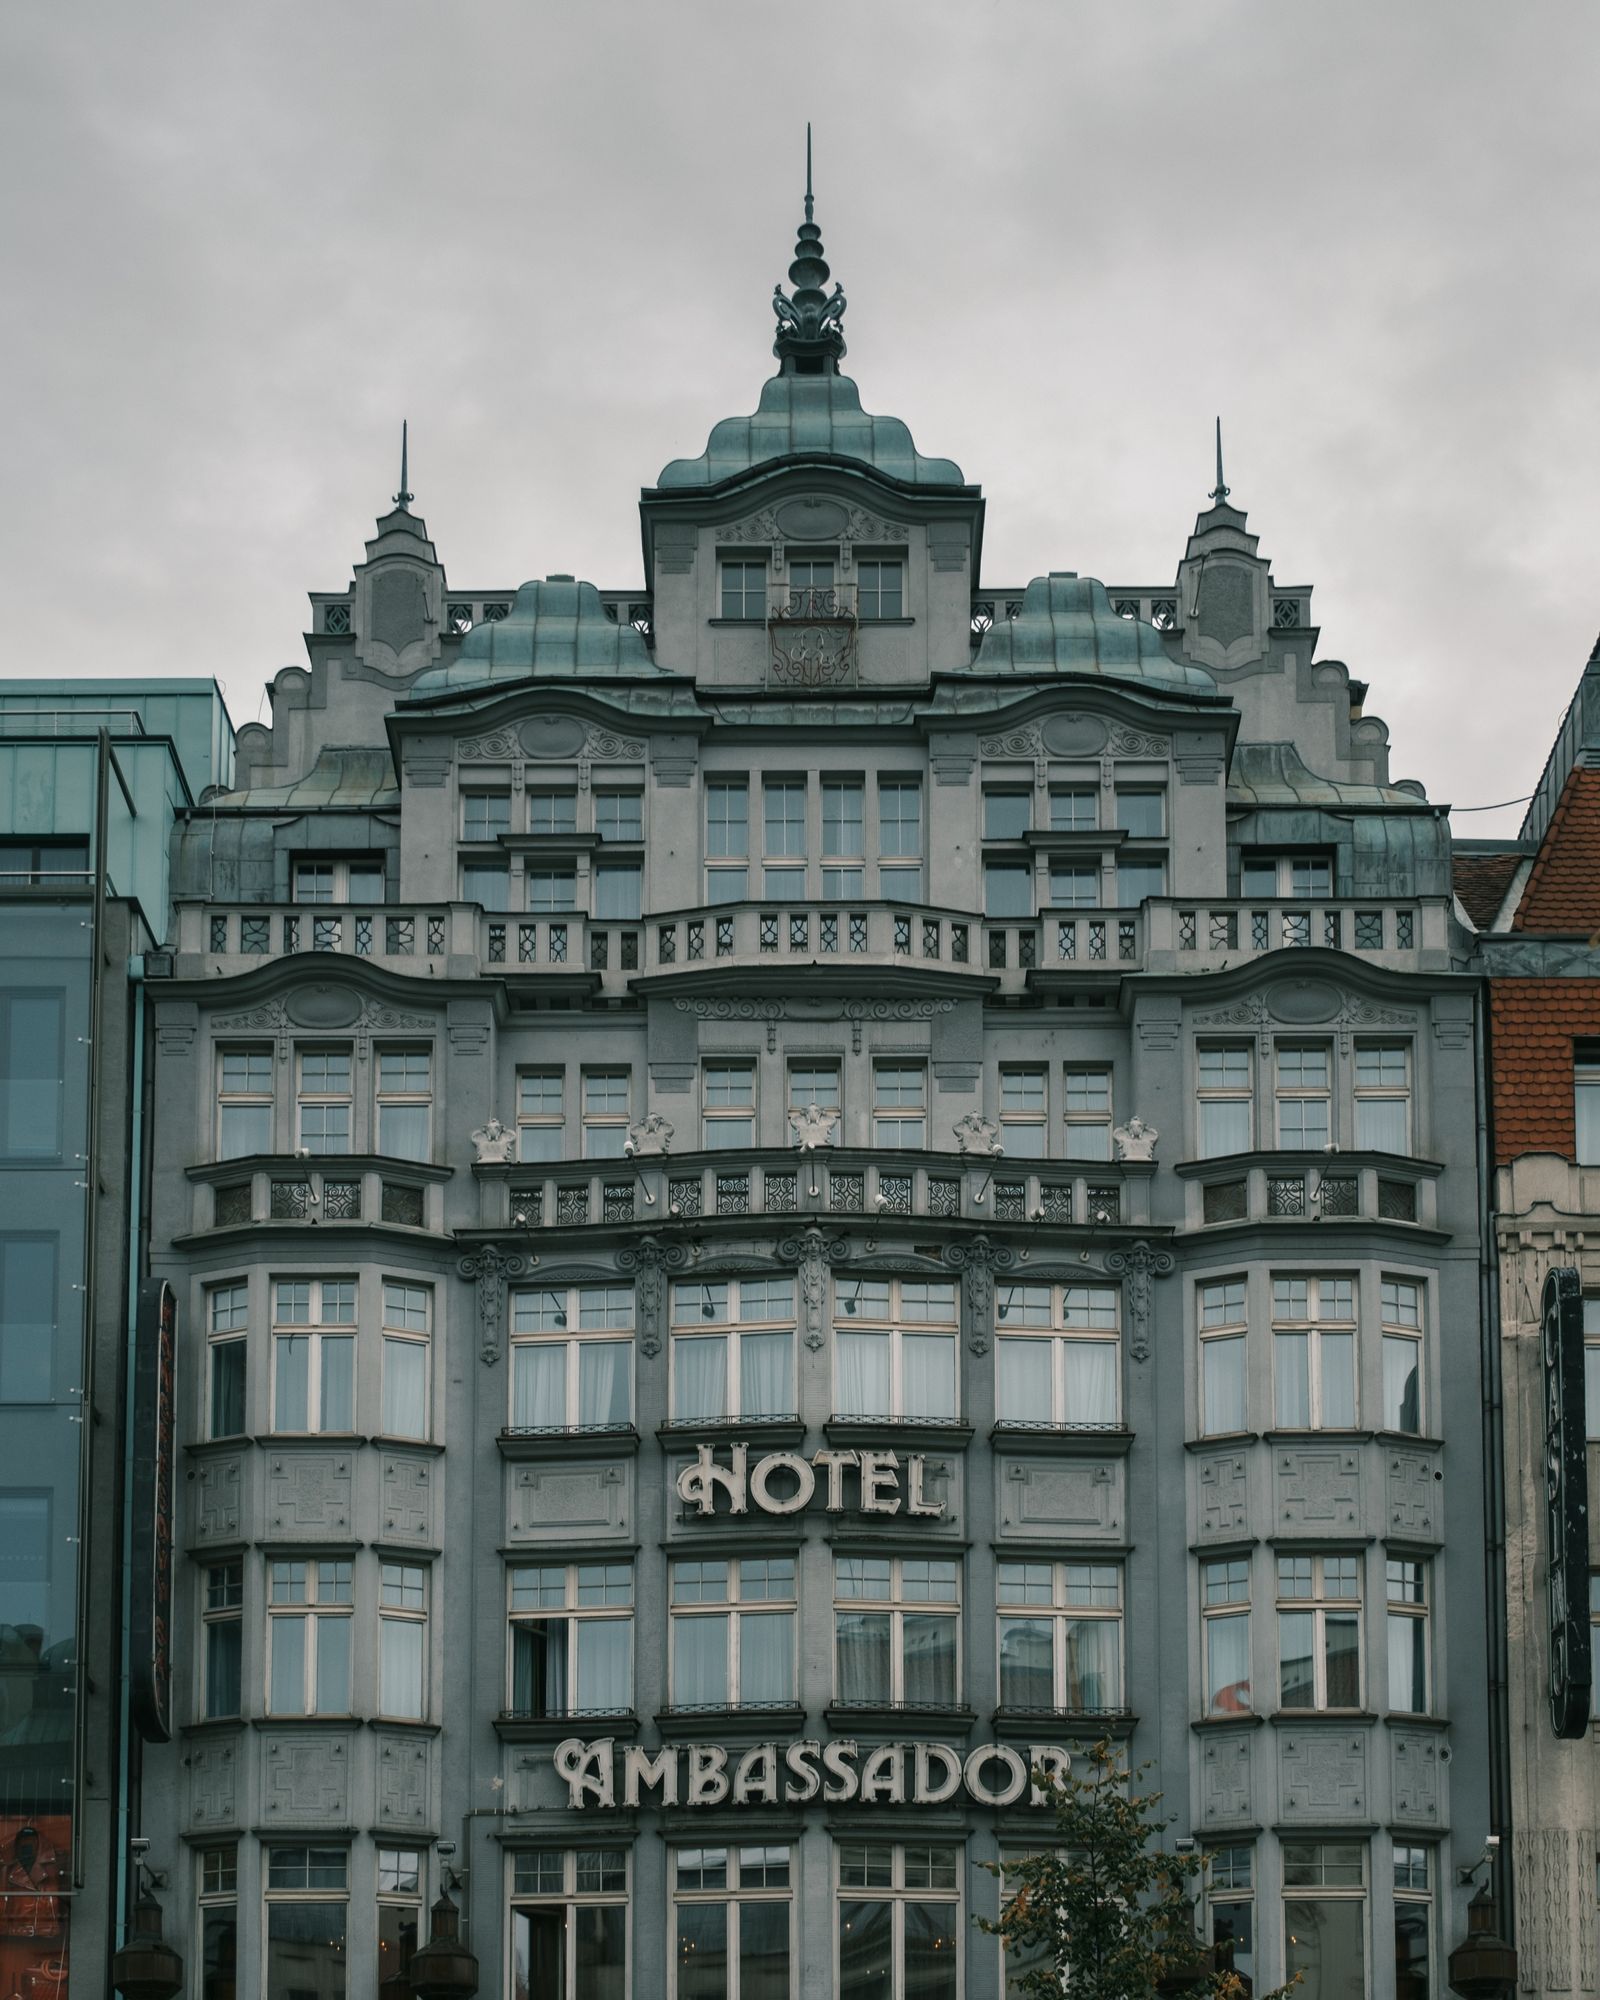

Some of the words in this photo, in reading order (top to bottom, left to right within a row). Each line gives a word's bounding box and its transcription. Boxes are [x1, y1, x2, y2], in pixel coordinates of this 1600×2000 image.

[676, 1441, 947, 1517] HOTEL
[1545, 1302, 1565, 1697] CASINO
[552, 1736, 1072, 1810] AMBASSADOR
